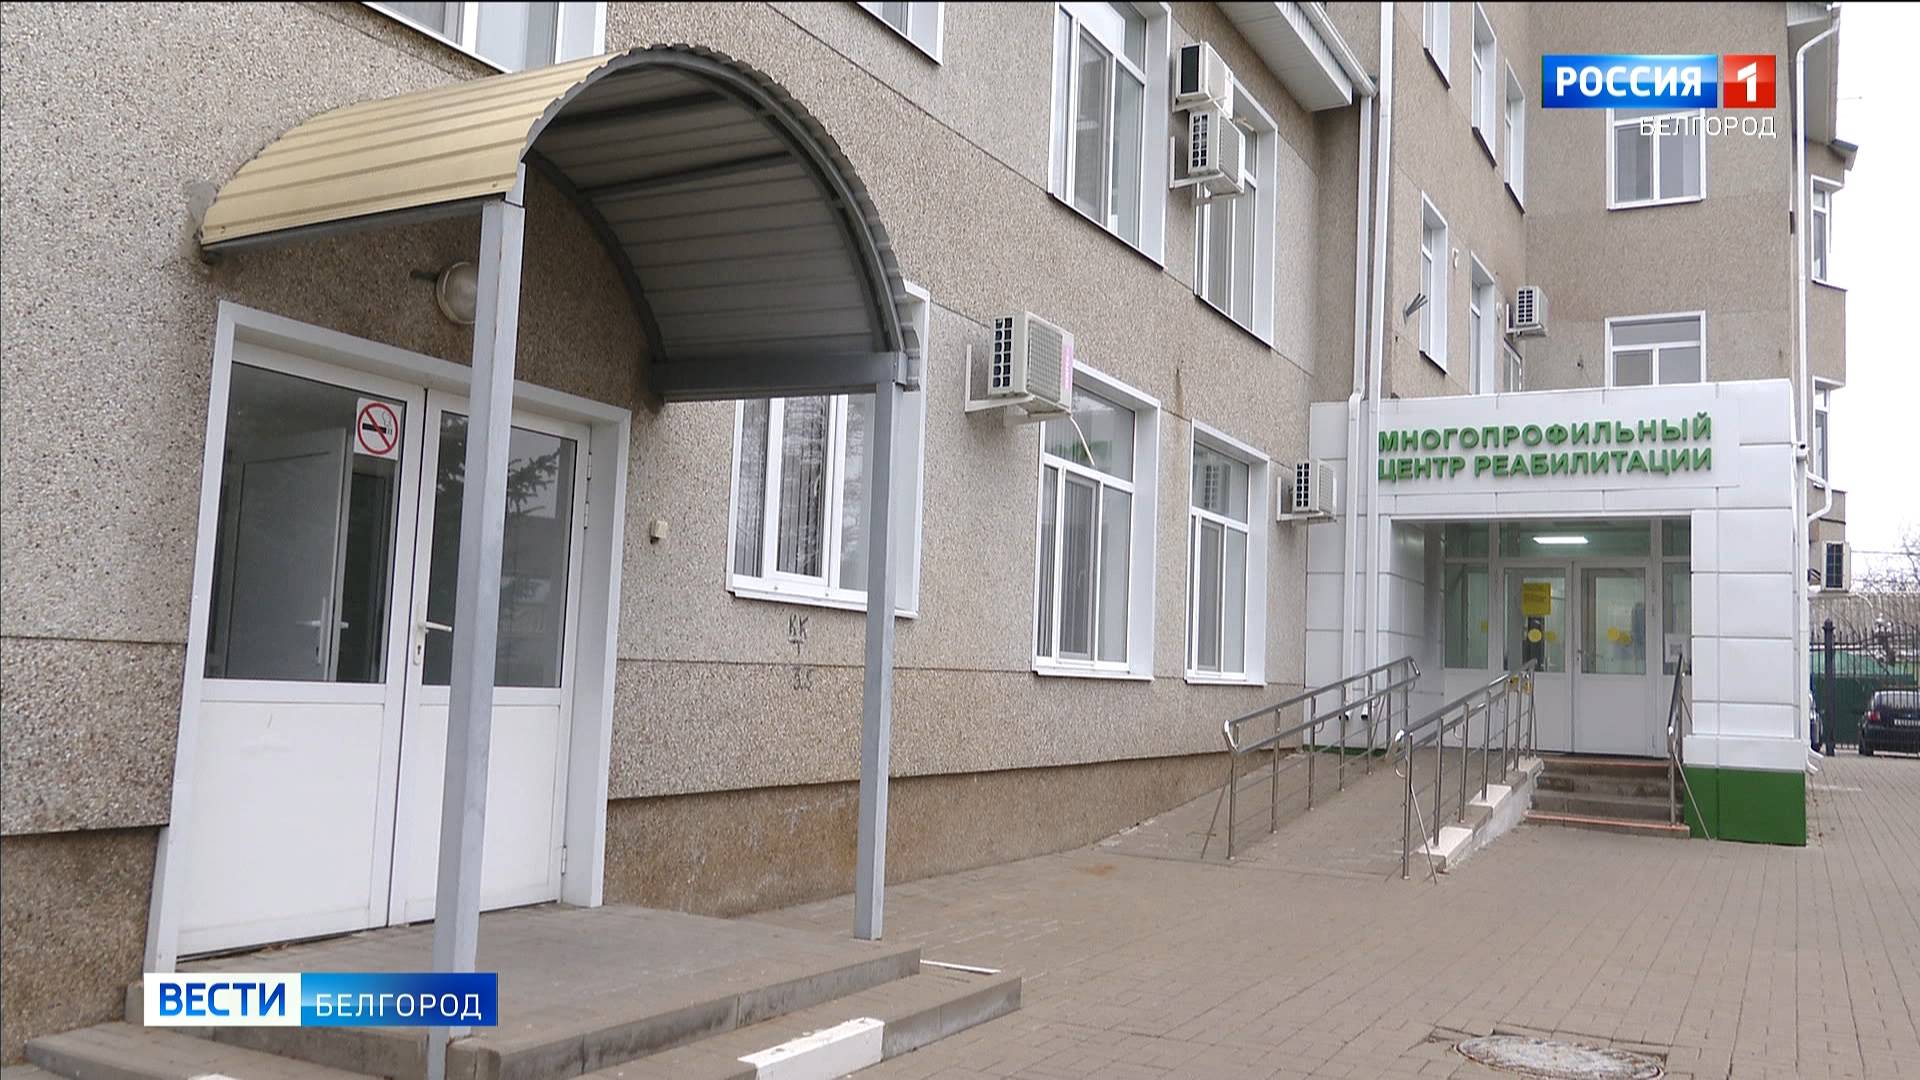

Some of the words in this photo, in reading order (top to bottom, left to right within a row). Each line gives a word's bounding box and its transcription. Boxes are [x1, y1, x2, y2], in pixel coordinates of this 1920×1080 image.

[1378, 412, 1713, 452] МНОГОПРОФИЛЬНЫЙ
[1378, 455, 1466, 482] ЦЕНТР
[1474, 448, 1713, 478] РЕАБИЛИТАЦИИ
